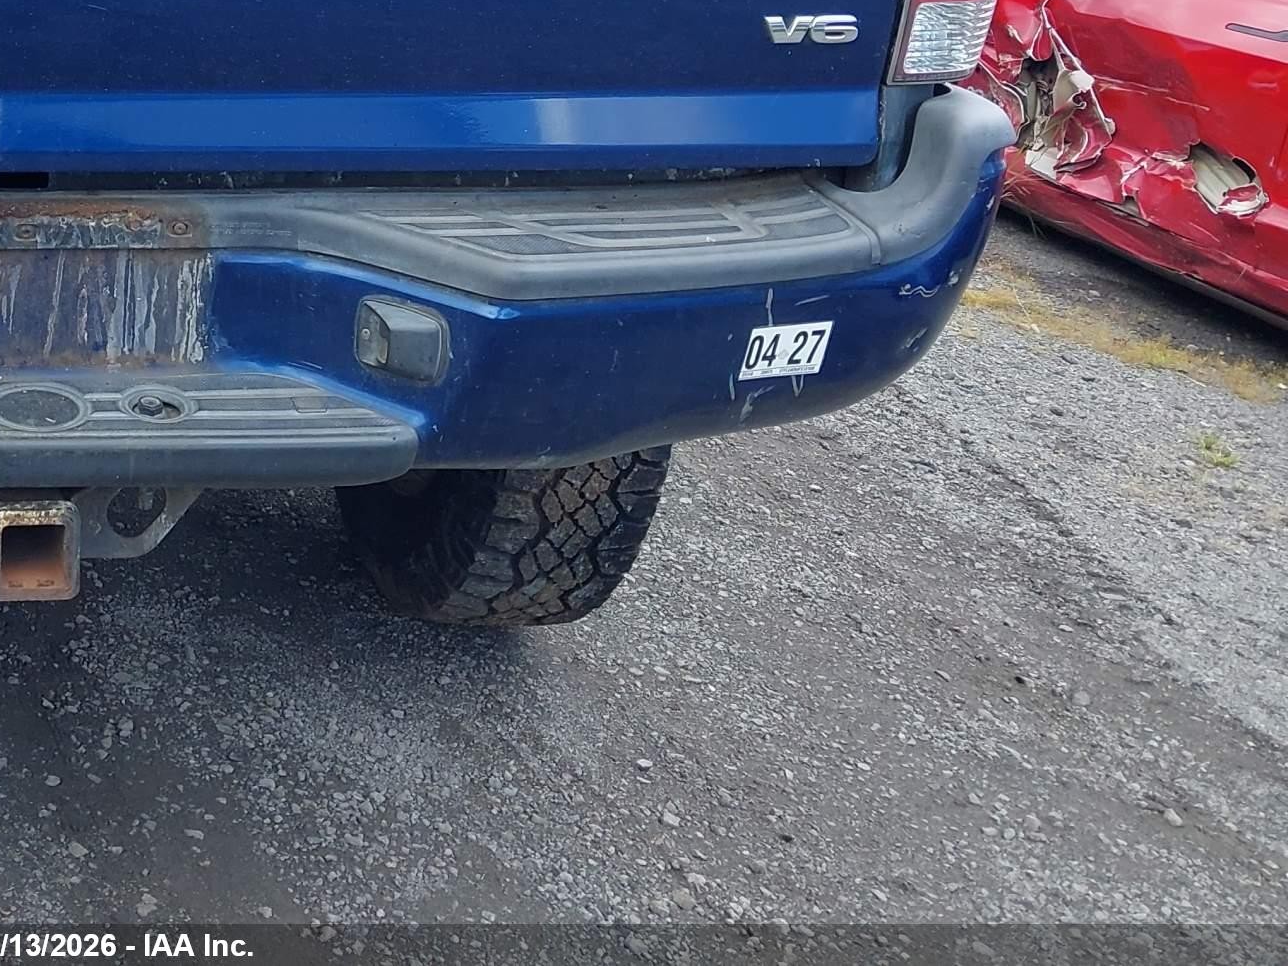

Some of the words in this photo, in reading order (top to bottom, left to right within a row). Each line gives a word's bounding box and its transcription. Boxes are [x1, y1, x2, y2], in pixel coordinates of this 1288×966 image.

[764, 14, 859, 44] V6
[745, 333, 782, 370] 04
[786, 329, 827, 366] 27
